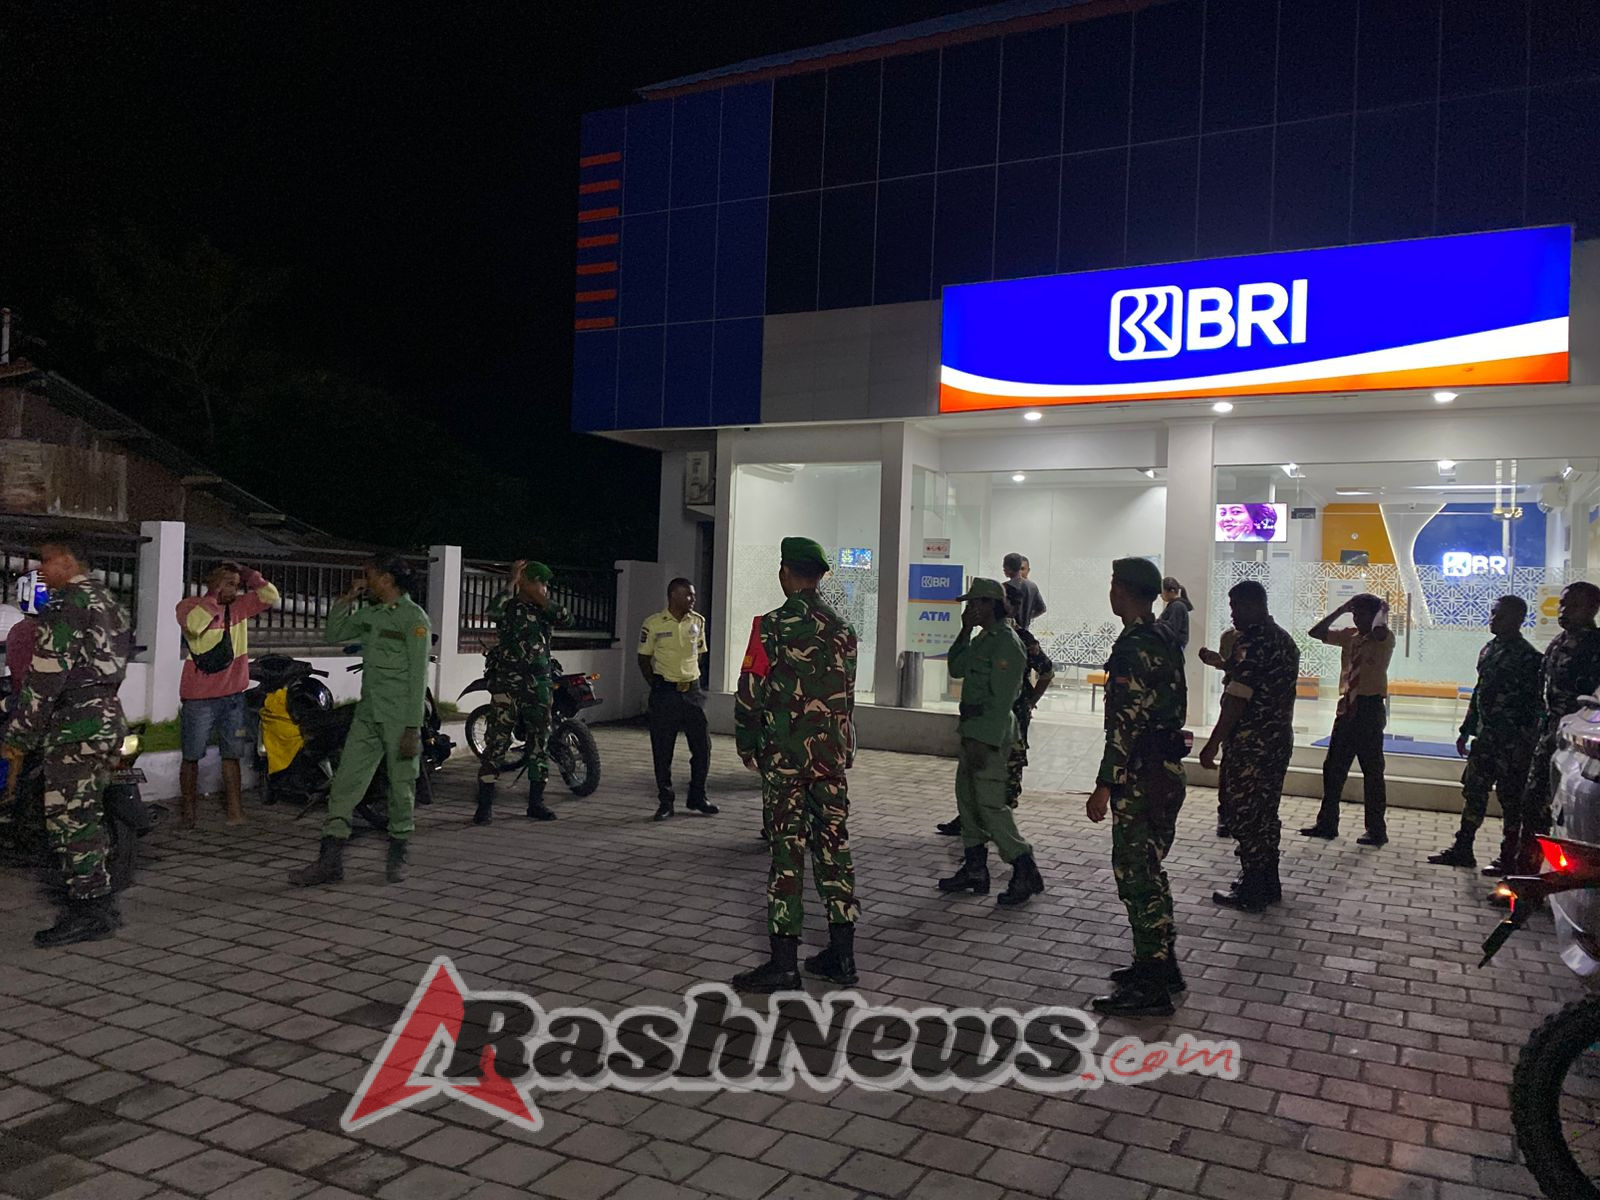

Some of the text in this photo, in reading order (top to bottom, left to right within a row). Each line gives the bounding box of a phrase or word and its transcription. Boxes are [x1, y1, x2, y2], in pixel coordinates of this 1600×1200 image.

[1186, 279, 1308, 351] BRI
[932, 577, 950, 588] BRI
[919, 611, 950, 622] ATM
